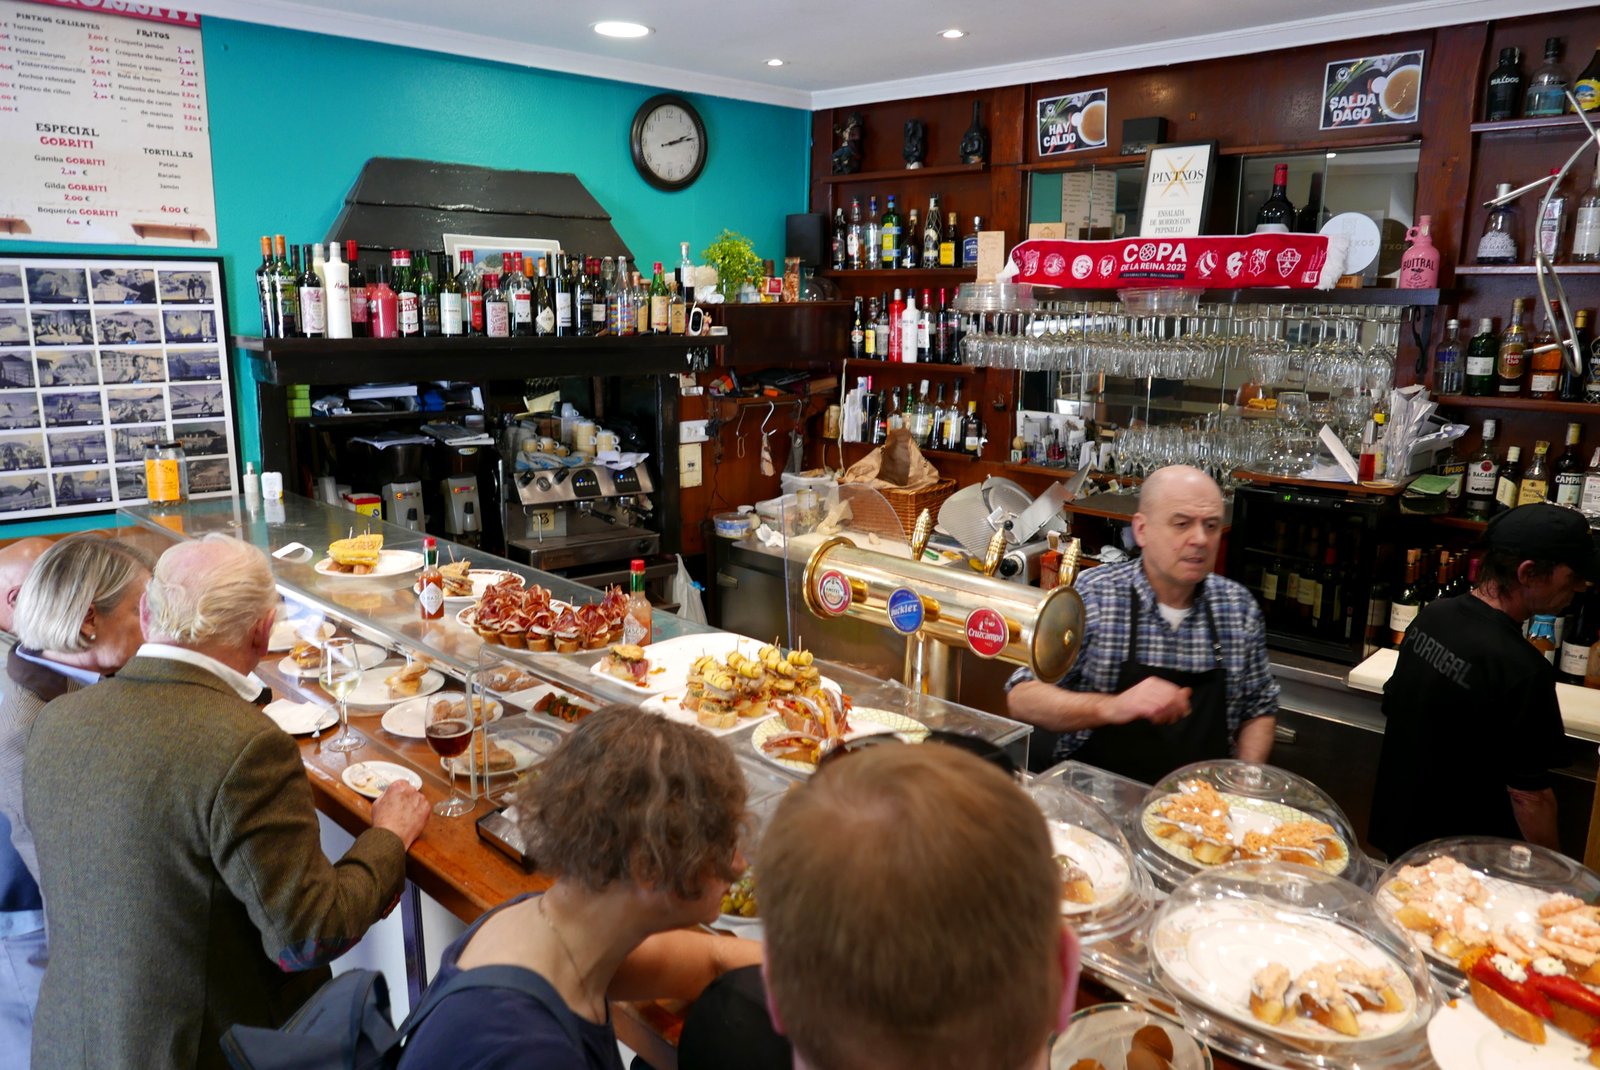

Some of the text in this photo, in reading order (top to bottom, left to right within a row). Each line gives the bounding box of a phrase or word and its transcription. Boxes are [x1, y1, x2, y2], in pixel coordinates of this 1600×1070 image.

[136, 28, 170, 40] FRITOS
[1329, 93, 1377, 110] SALDA
[1333, 107, 1372, 122] DAGO
[36, 122, 100, 137] ESPECIAL
[1049, 122, 1070, 135] HAY
[40, 136, 94, 150] GORRITI
[1043, 133, 1076, 147] CALDO
[34, 154, 105, 166] Gamba GORRITI
[143, 148, 194, 159] TORTILLAS
[1152, 169, 1204, 183] PINTXOS
[44, 182, 107, 192] Gilda GORRITI
[38, 206, 118, 217] Boquerón GORRITI
[160, 205, 181, 214] 4.00
[1158, 209, 1184, 217] ENSALADA
[1123, 243, 1187, 263] COPA
[1140, 262, 1165, 270] REINA
[1166, 263, 1186, 271] 2022
[1403, 258, 1434, 271] BUITRAL
[1555, 475, 1580, 484] CAMPA
[969, 628, 1003, 643] Cruzcampo
[1406, 626, 1472, 690] PORTUGAL
